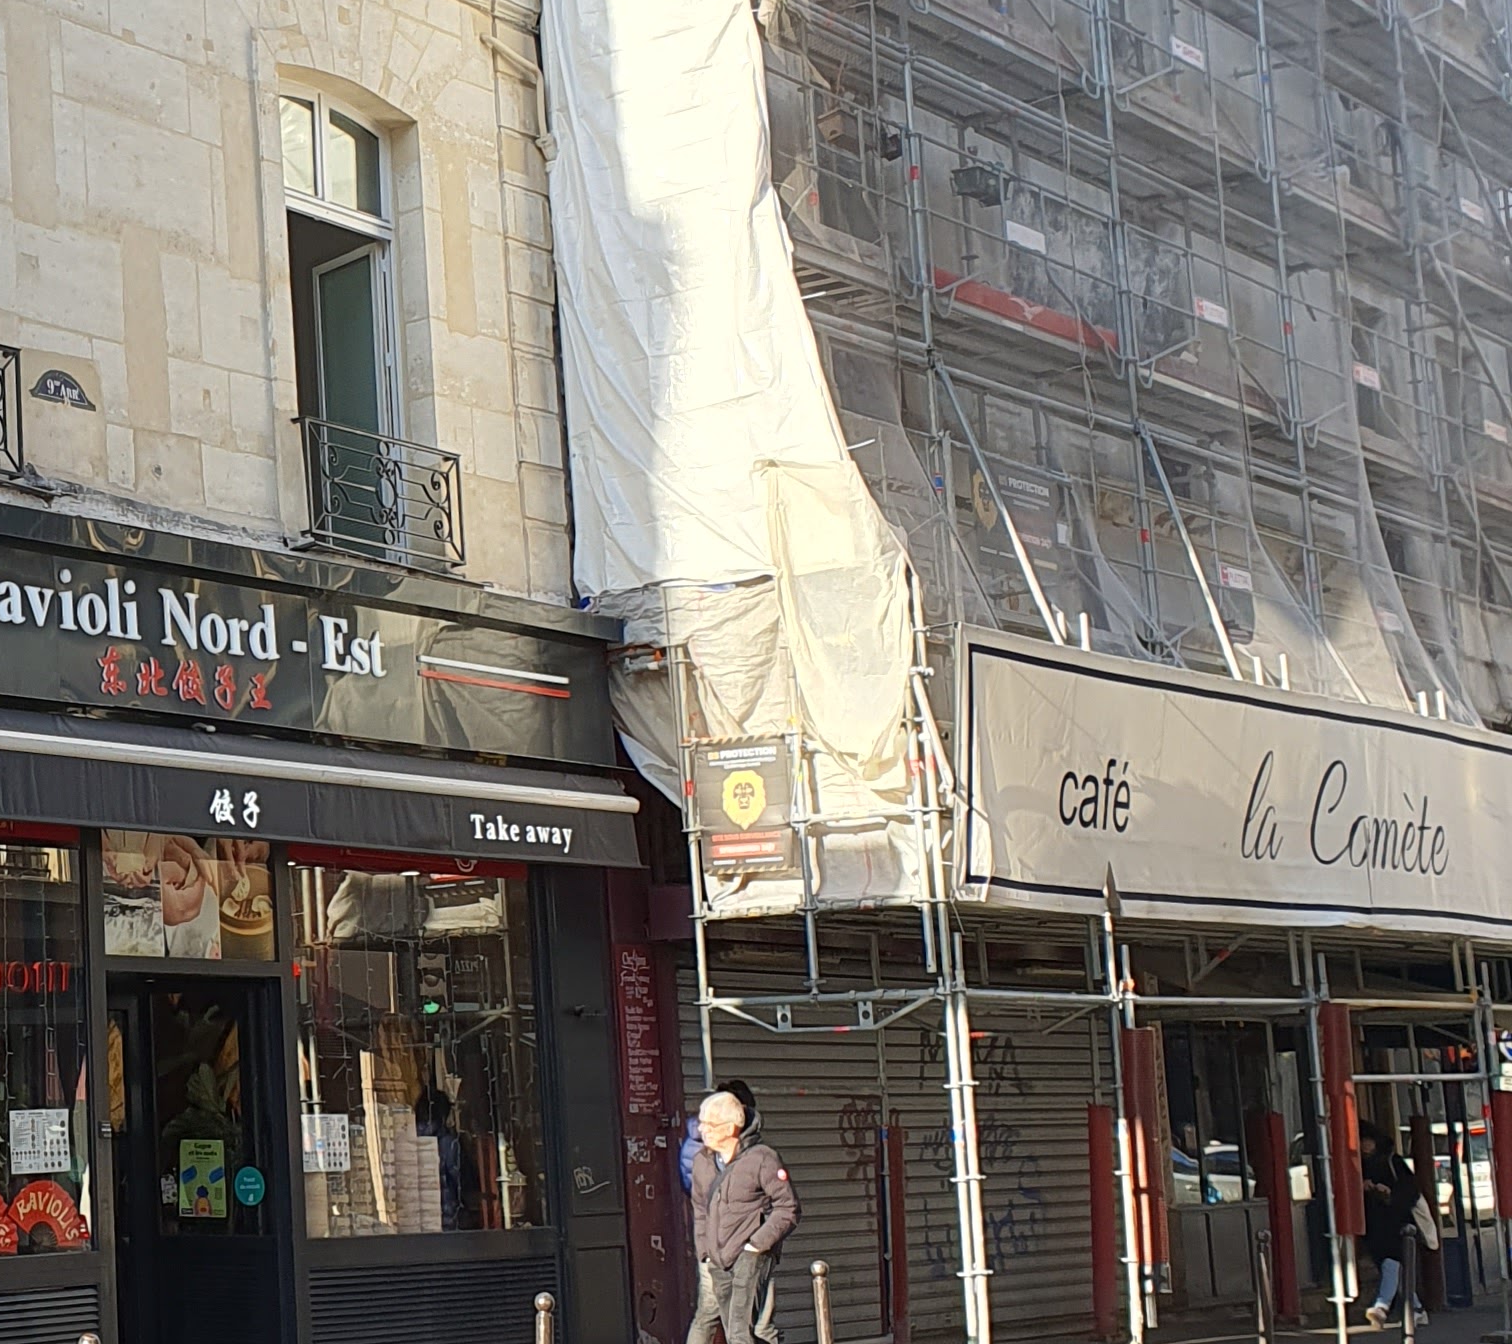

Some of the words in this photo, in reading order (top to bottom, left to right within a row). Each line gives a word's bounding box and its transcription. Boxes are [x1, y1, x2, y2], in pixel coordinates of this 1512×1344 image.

[157, 587, 281, 661] Nord
[319, 614, 387, 678] Est
[719, 745, 777, 760] PROTECTION
[470, 812, 520, 843] Take
[525, 824, 573, 854] away
[1059, 758, 1132, 833] café
[1241, 750, 1284, 861] la
[1310, 759, 1449, 876] Comète
[16, 1191, 79, 1241] RAVIOLIS
